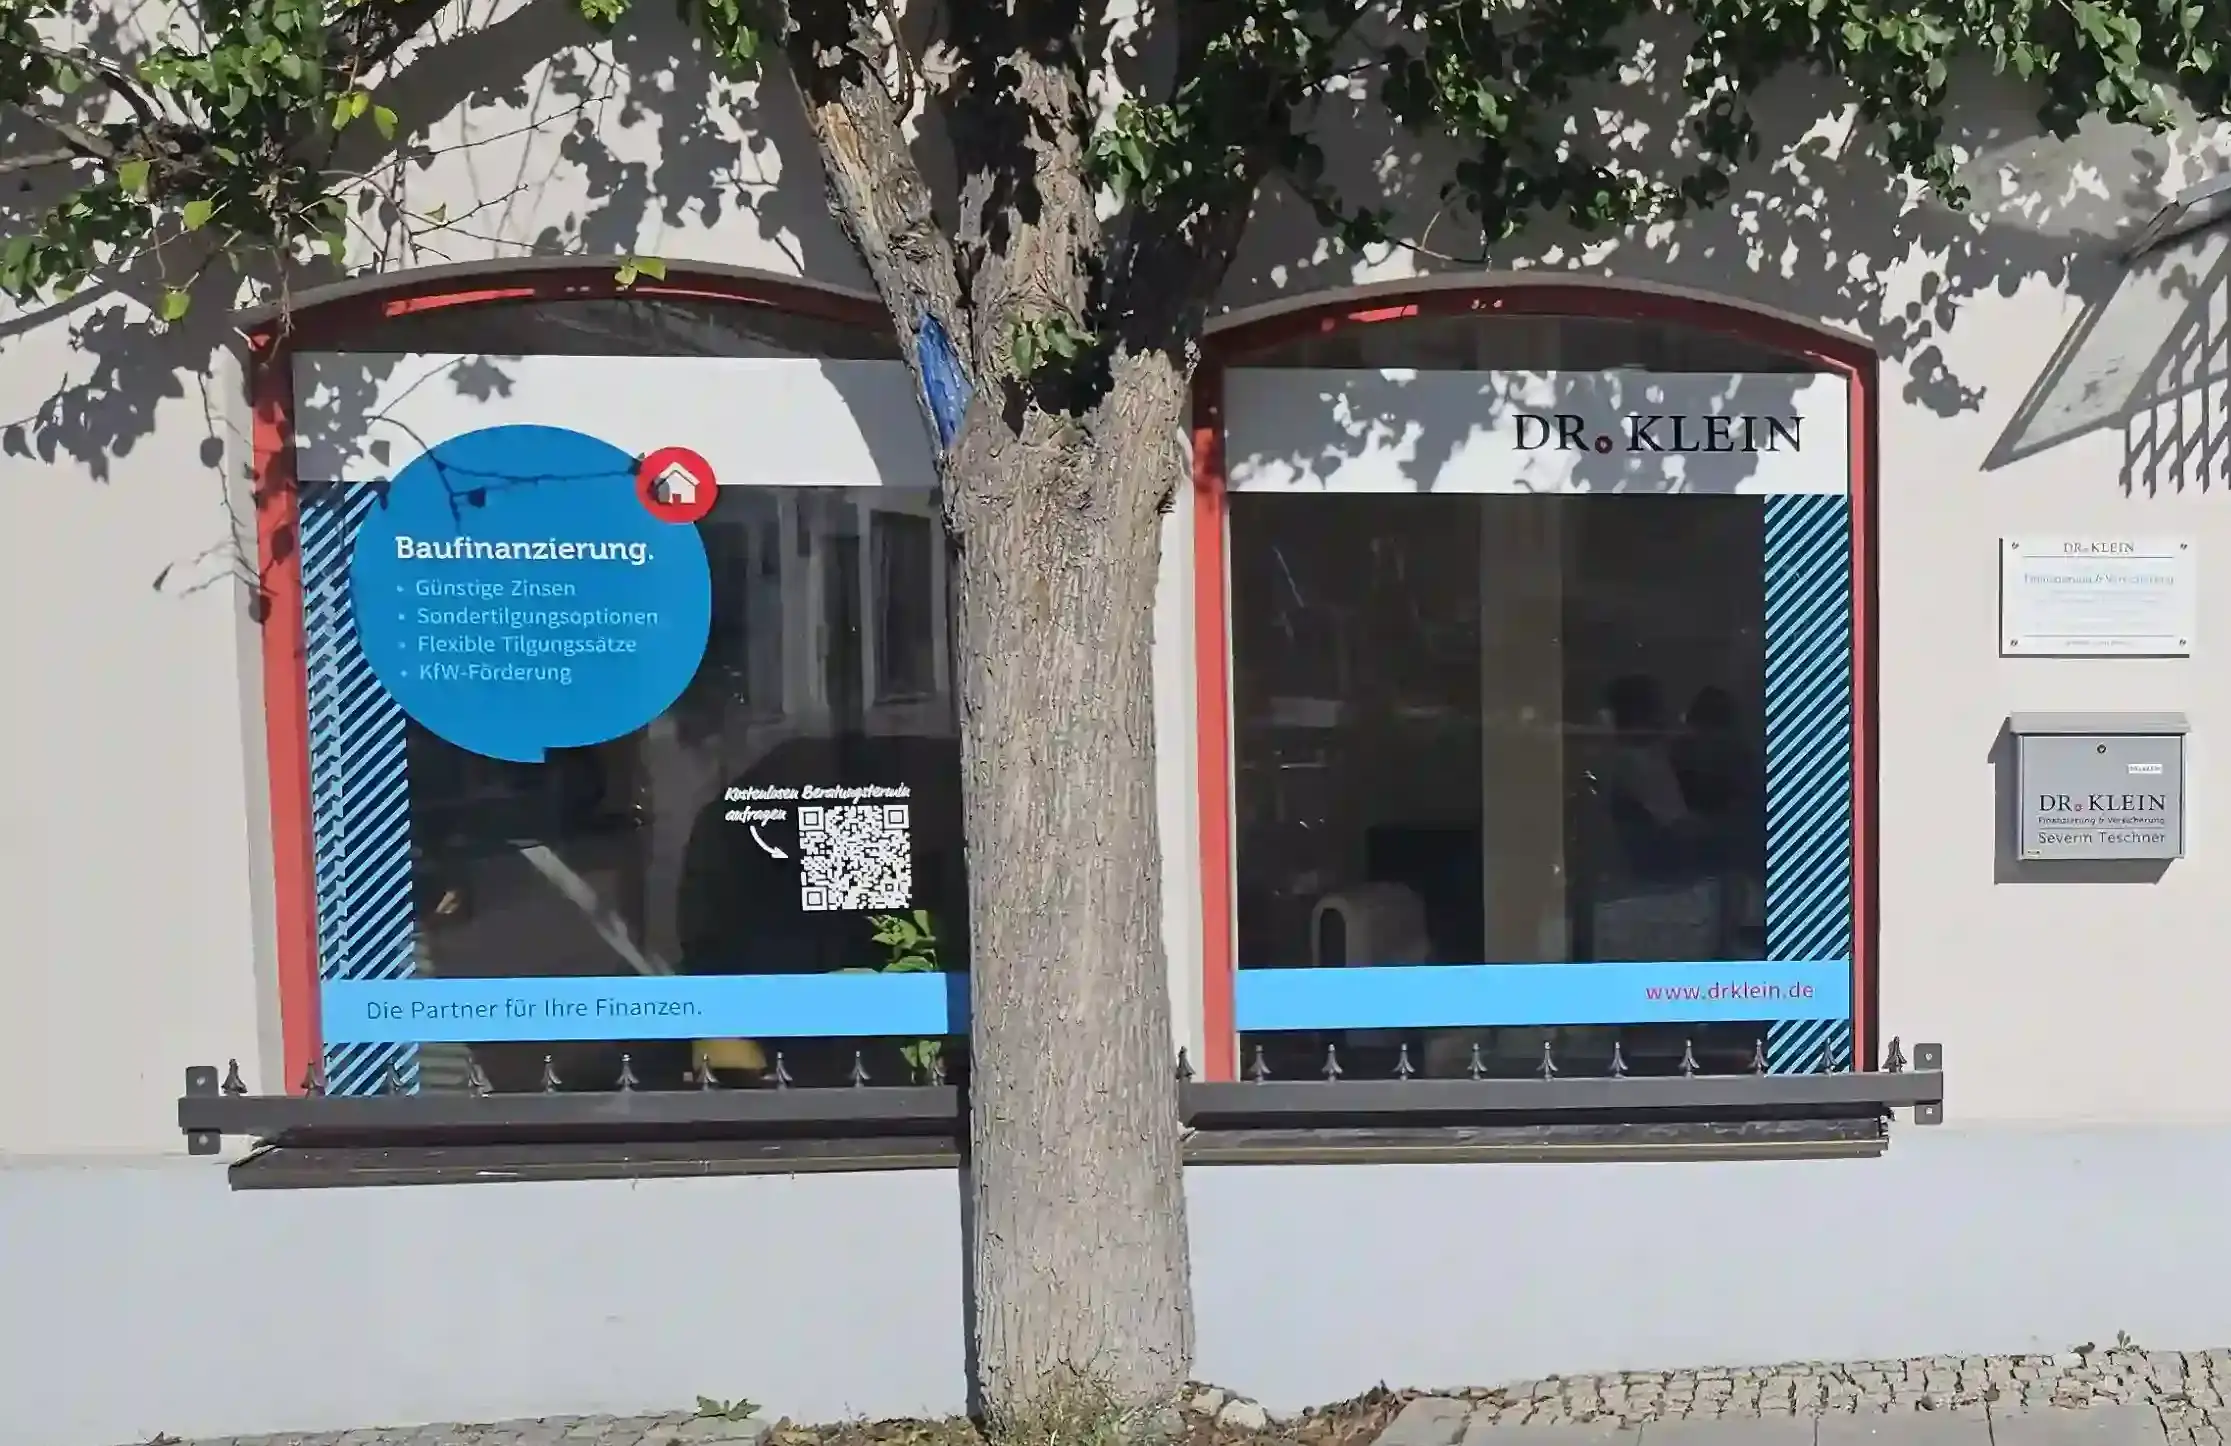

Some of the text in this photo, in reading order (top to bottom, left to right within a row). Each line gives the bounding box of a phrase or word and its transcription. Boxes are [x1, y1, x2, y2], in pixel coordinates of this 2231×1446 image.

[1624, 414, 1806, 453] KLEIN
[395, 536, 654, 566] Baufinanzierung.
[2091, 541, 2135, 553] KLEIN
[416, 579, 576, 599] Günstige Zinsen
[417, 607, 658, 628] Sondertilgungsoptionen
[418, 635, 637, 657] Flexible Tilgungssätze
[419, 662, 573, 685] KfW-Förderung
[724, 782, 911, 805] Kostenlosen Beratungstermin
[2088, 794, 2166, 811] KLEIN
[725, 806, 787, 827] anfragen
[2038, 816, 2096, 825] Finanzierung
[2107, 816, 2165, 825] Versicherung
[2099, 831, 2166, 843] Teschner
[1646, 981, 1815, 1000] www.drklein.de
[367, 998, 702, 1020] Die Partner für Ihre Finanzen.
